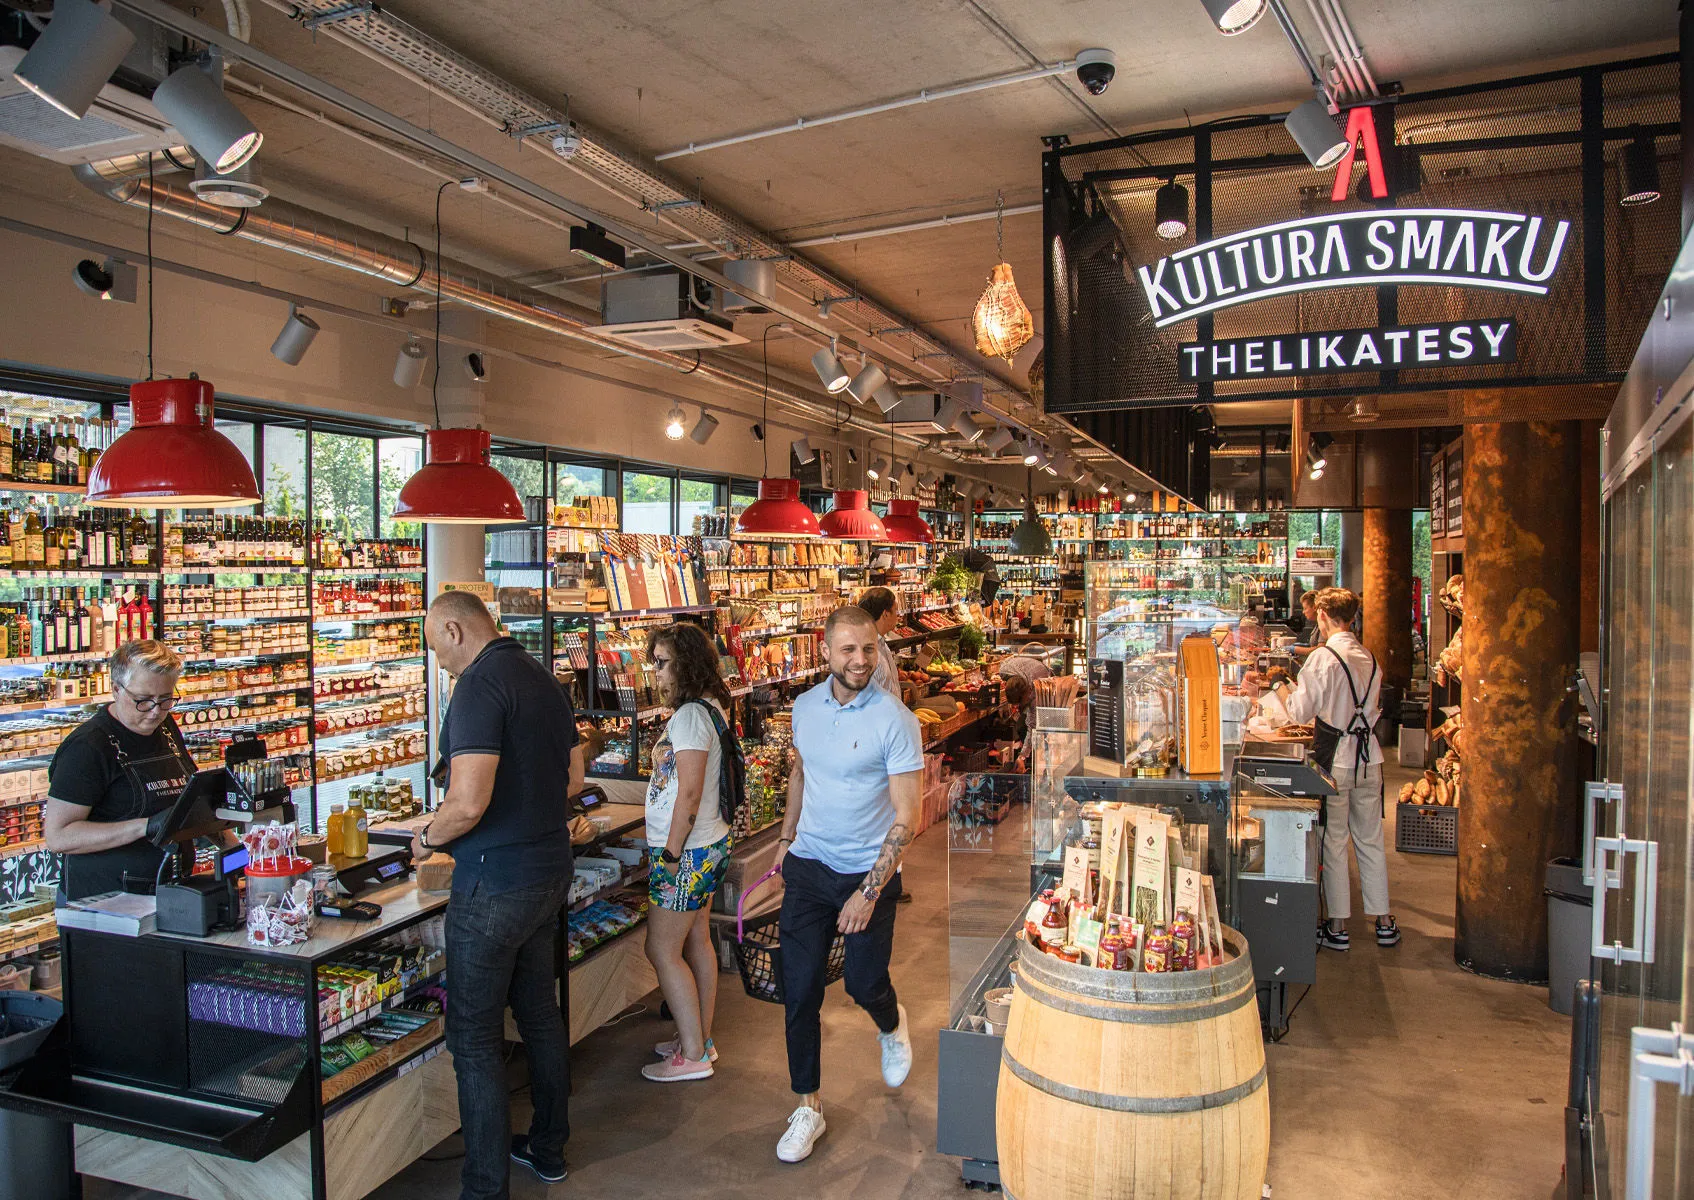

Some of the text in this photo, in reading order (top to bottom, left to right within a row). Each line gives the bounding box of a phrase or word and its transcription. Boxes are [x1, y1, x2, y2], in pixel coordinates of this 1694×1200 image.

[1138, 216, 1570, 318] KULTURA SMAKU
[1183, 323, 1510, 377] THELIKATESY
